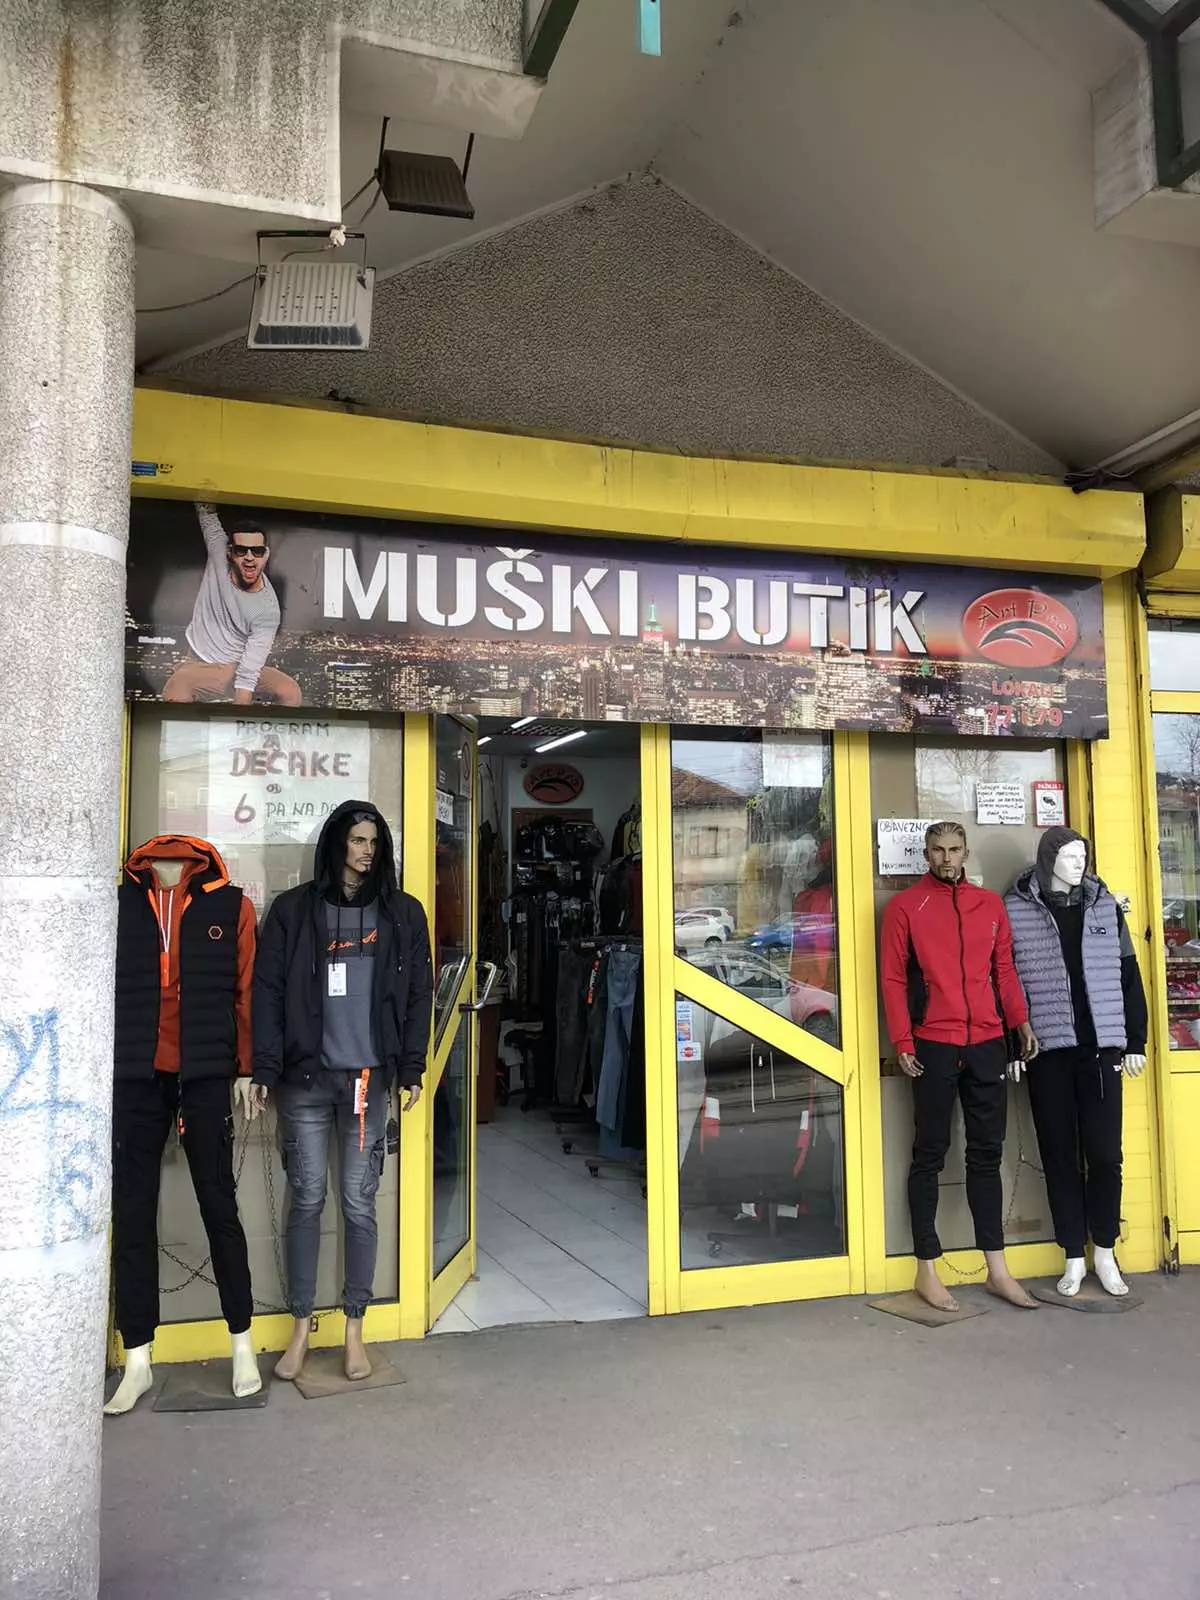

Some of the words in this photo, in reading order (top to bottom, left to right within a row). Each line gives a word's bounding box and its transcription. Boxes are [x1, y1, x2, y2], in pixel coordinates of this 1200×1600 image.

[323, 546, 638, 637] MUŠKI
[677, 573, 927, 654] BUTIK
[976, 602, 1016, 629] Art
[235, 720, 330, 736] PROGRAM
[987, 703, 1014, 726] 77
[229, 746, 352, 777] DEČAKE
[234, 793, 256, 823] 6
[292, 802, 314, 817] NA
[319, 802, 338, 817] DA
[880, 820, 929, 832] OBAVEZNO
